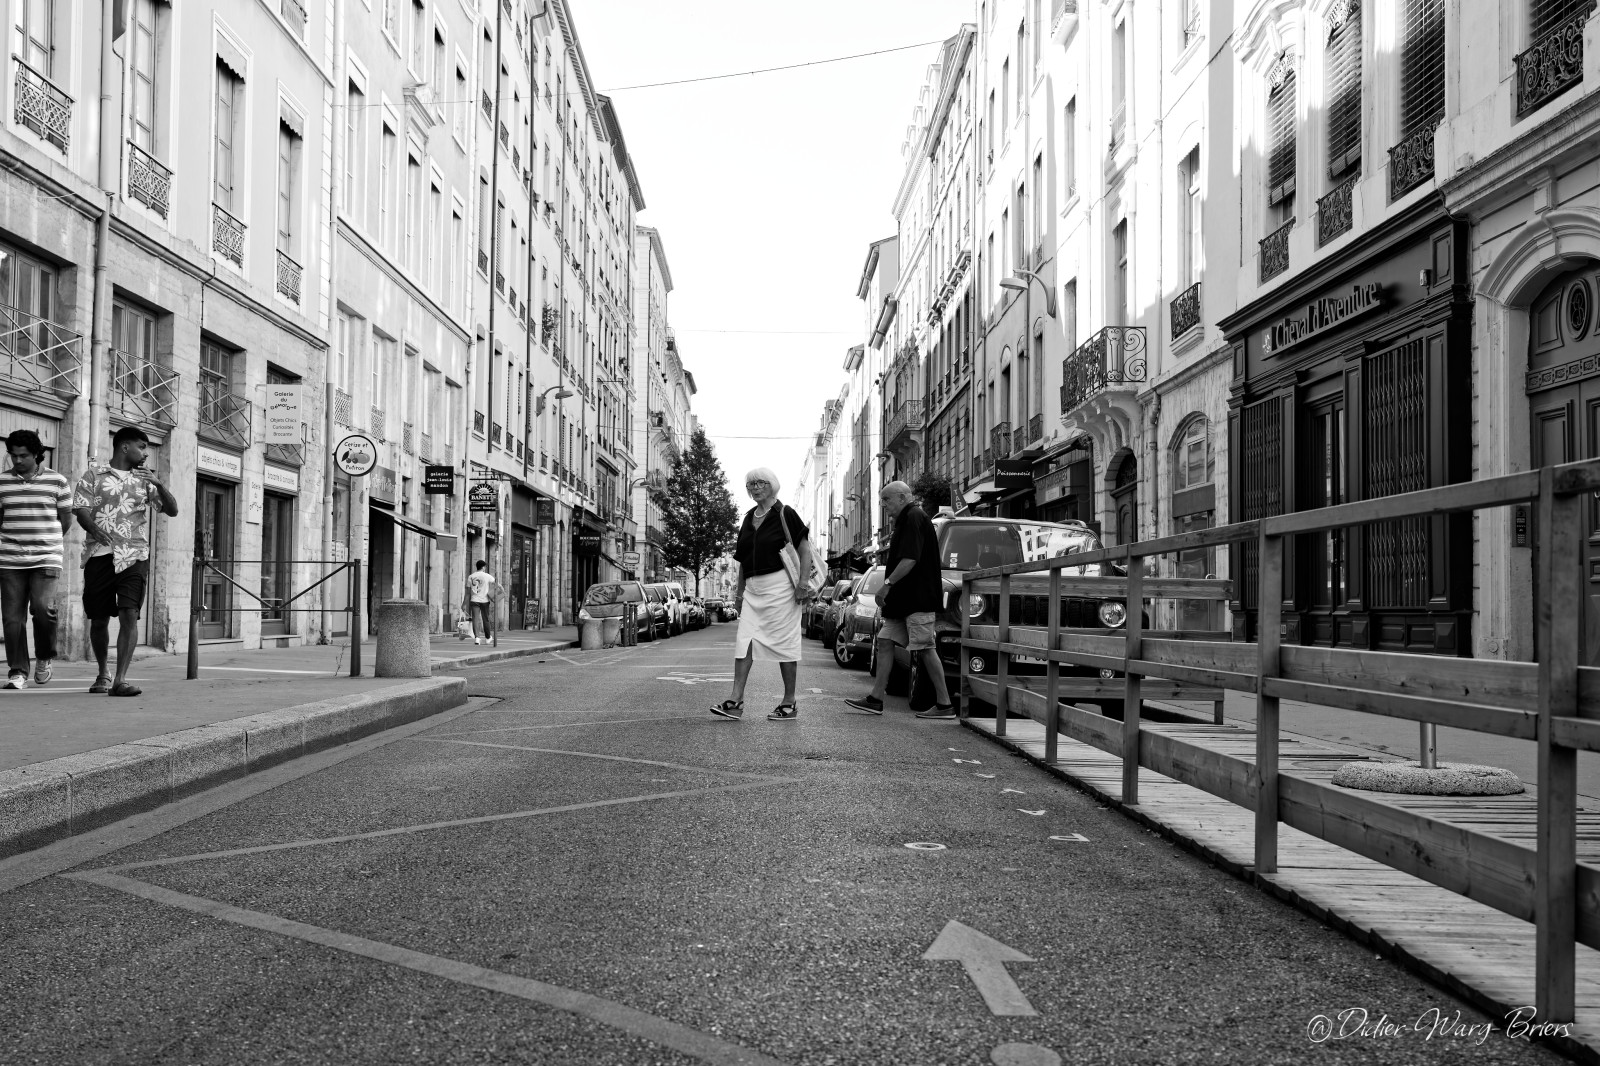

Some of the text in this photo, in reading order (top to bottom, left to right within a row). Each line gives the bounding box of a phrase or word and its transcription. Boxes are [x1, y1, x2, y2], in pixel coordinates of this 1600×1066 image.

[1276, 282, 1377, 347] Cheval d'Aventure
[996, 468, 1031, 476] Poissonnerie
